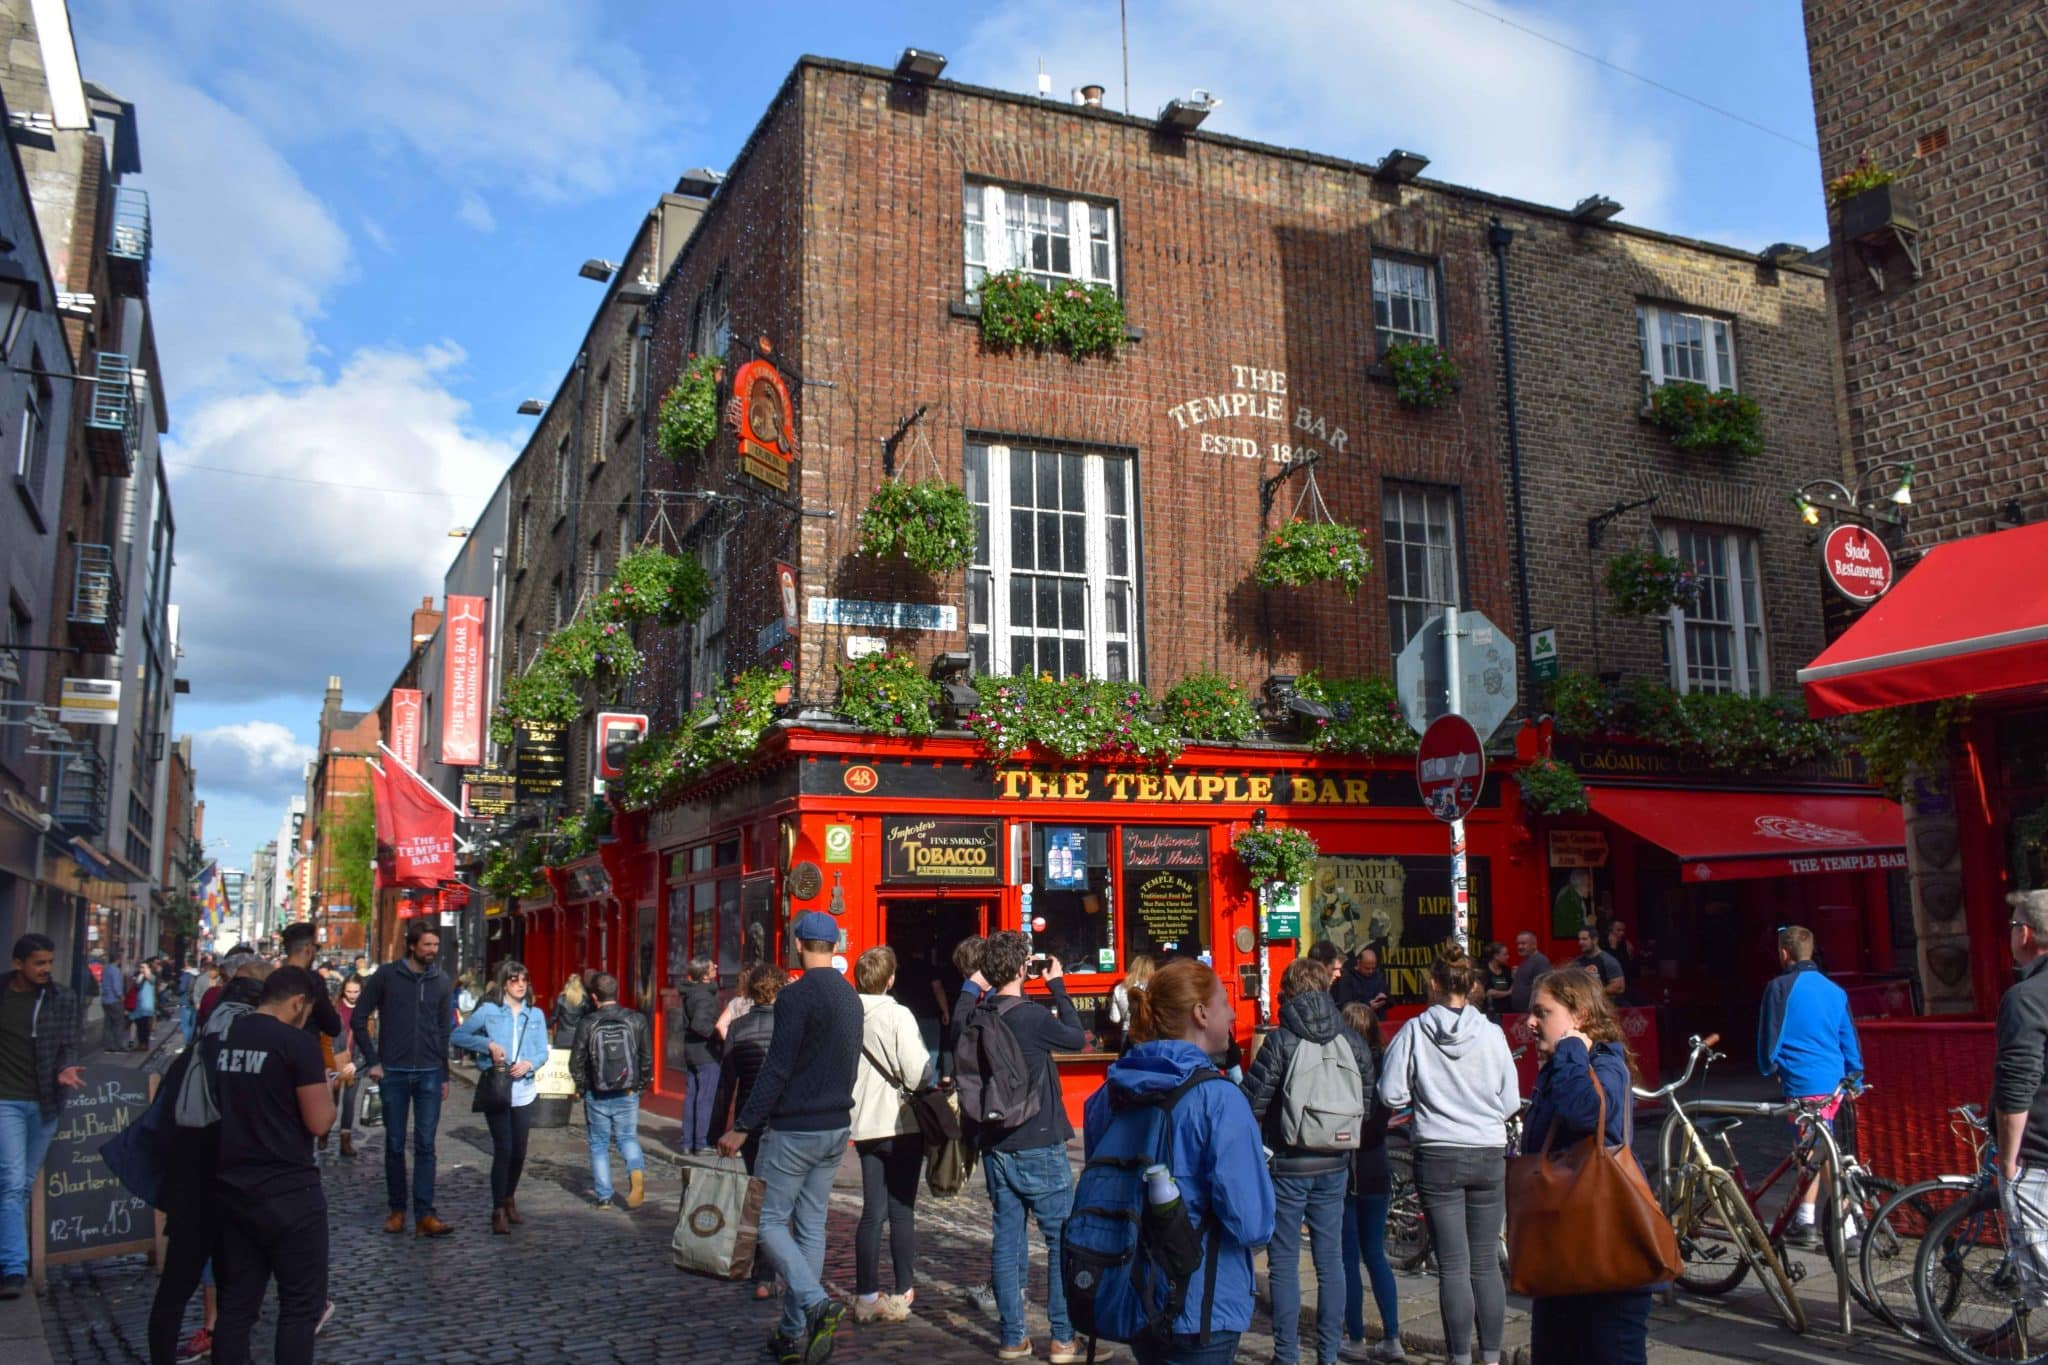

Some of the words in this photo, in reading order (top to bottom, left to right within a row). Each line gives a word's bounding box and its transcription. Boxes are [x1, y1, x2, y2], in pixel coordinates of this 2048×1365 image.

[1231, 364, 1288, 395] THE
[1168, 393, 1284, 432] TEMPLE
[1293, 405, 1349, 453] BAR
[1200, 432, 1263, 459] ESTD.
[1844, 536, 1872, 562] Shack
[454, 627, 467, 653] BAR
[452, 655, 466, 708] TEMPLE
[465, 666, 477, 718] TRADING
[452, 711, 465, 736] THE
[850, 769, 871, 786] 48
[994, 770, 1091, 799] THE
[1105, 772, 1274, 803] TEMPLE
[1291, 777, 1370, 804] BAR
[413, 836, 436, 846] THE
[887, 821, 937, 842] Importers
[929, 836, 949, 846] FINE
[950, 837, 987, 847] SMOKING
[397, 842, 450, 857] TEMPLE
[411, 854, 441, 866] BAR
[901, 841, 987, 872] TOBACCO
[1335, 864, 1402, 880] TEMPLE
[1789, 858, 1819, 873] THE
[1821, 855, 1877, 871] TEMPLE
[1878, 853, 1907, 868] BAR
[1140, 875, 1175, 892] TEMPLE
[1176, 878, 1193, 893] BAR
[1354, 880, 1386, 896] BAR
[1381, 945, 1433, 966] MALTED
[217, 1048, 268, 1074] REW
[65, 1092, 97, 1108] exico
